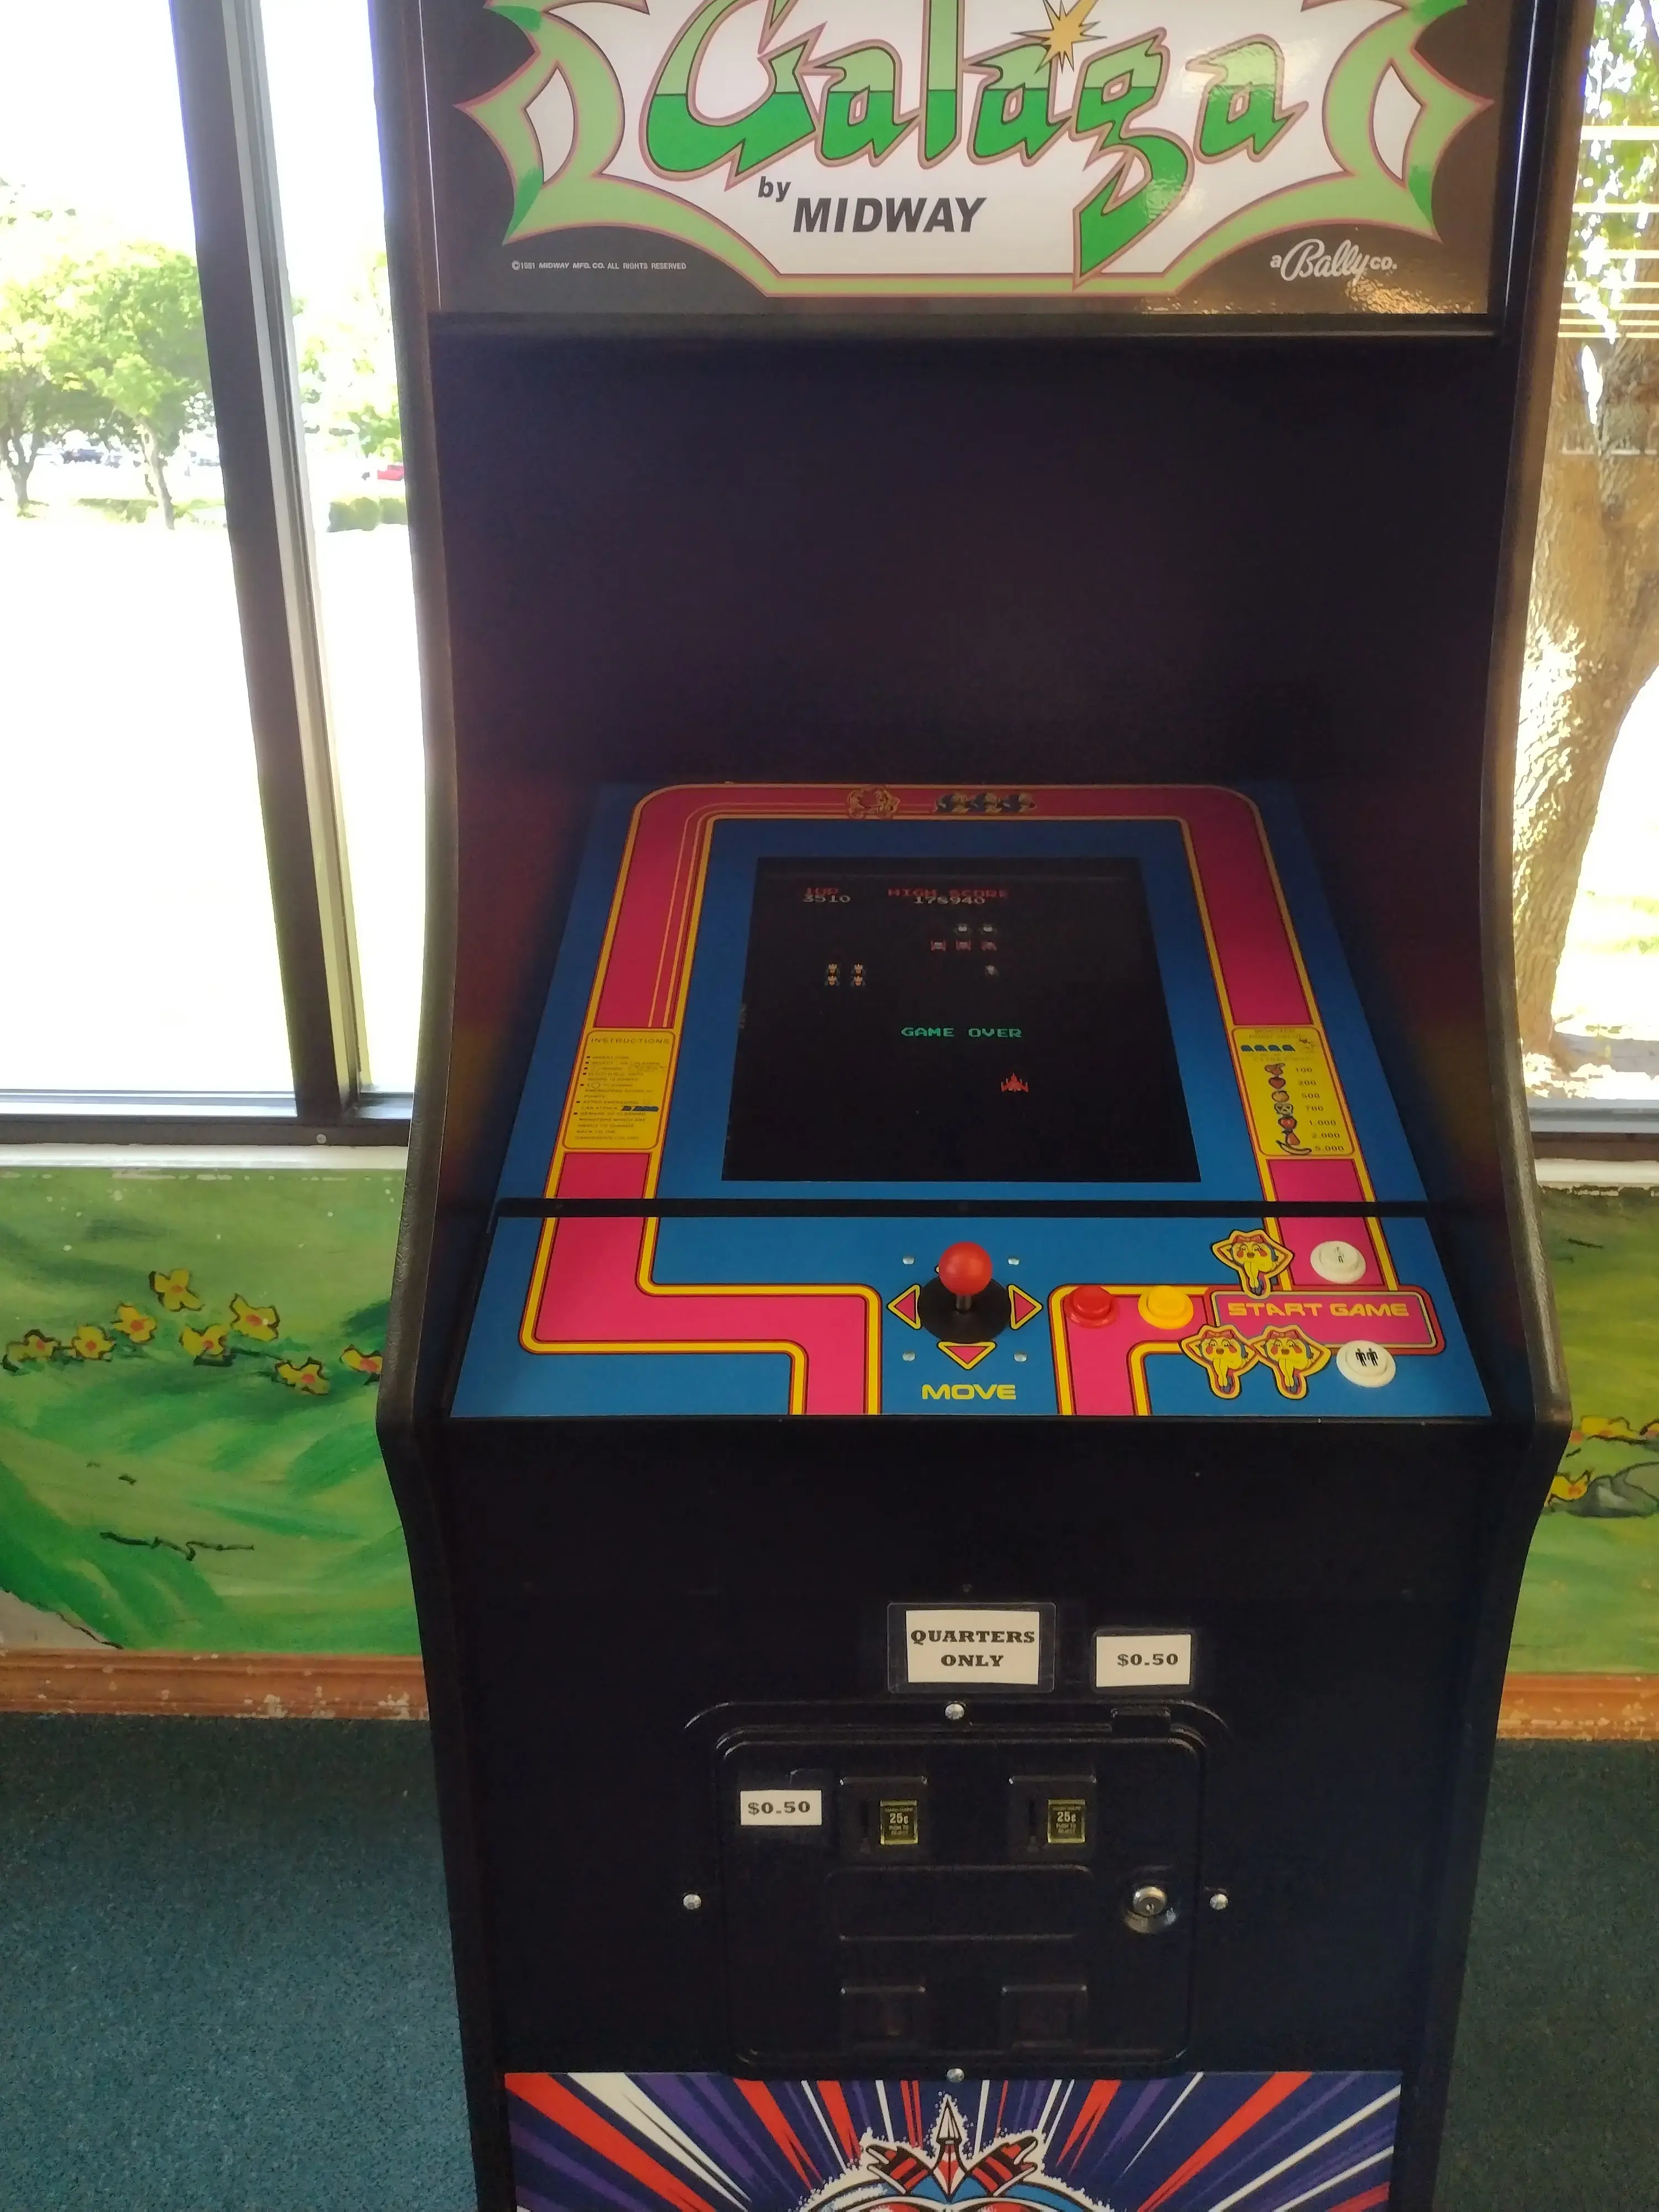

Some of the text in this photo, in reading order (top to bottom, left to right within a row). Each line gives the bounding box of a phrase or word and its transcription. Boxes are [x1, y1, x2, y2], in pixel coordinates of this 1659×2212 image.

[758, 176, 791, 202] by
[793, 197, 987, 232] MIDWAY
[1270, 255, 1282, 268] a
[1280, 238, 1370, 286] Bally
[949, 889, 1008, 898] SCORE
[901, 1027, 1022, 1037] GAME OVER
[1228, 1302, 1409, 1317] START GAME
[922, 1384, 1016, 1400] MOVE
[911, 1630, 1035, 1645] QUARTERS
[941, 1654, 1004, 1667] ONLY
[1117, 1653, 1178, 1667] $0.50
[748, 1801, 811, 1816] $0.50
